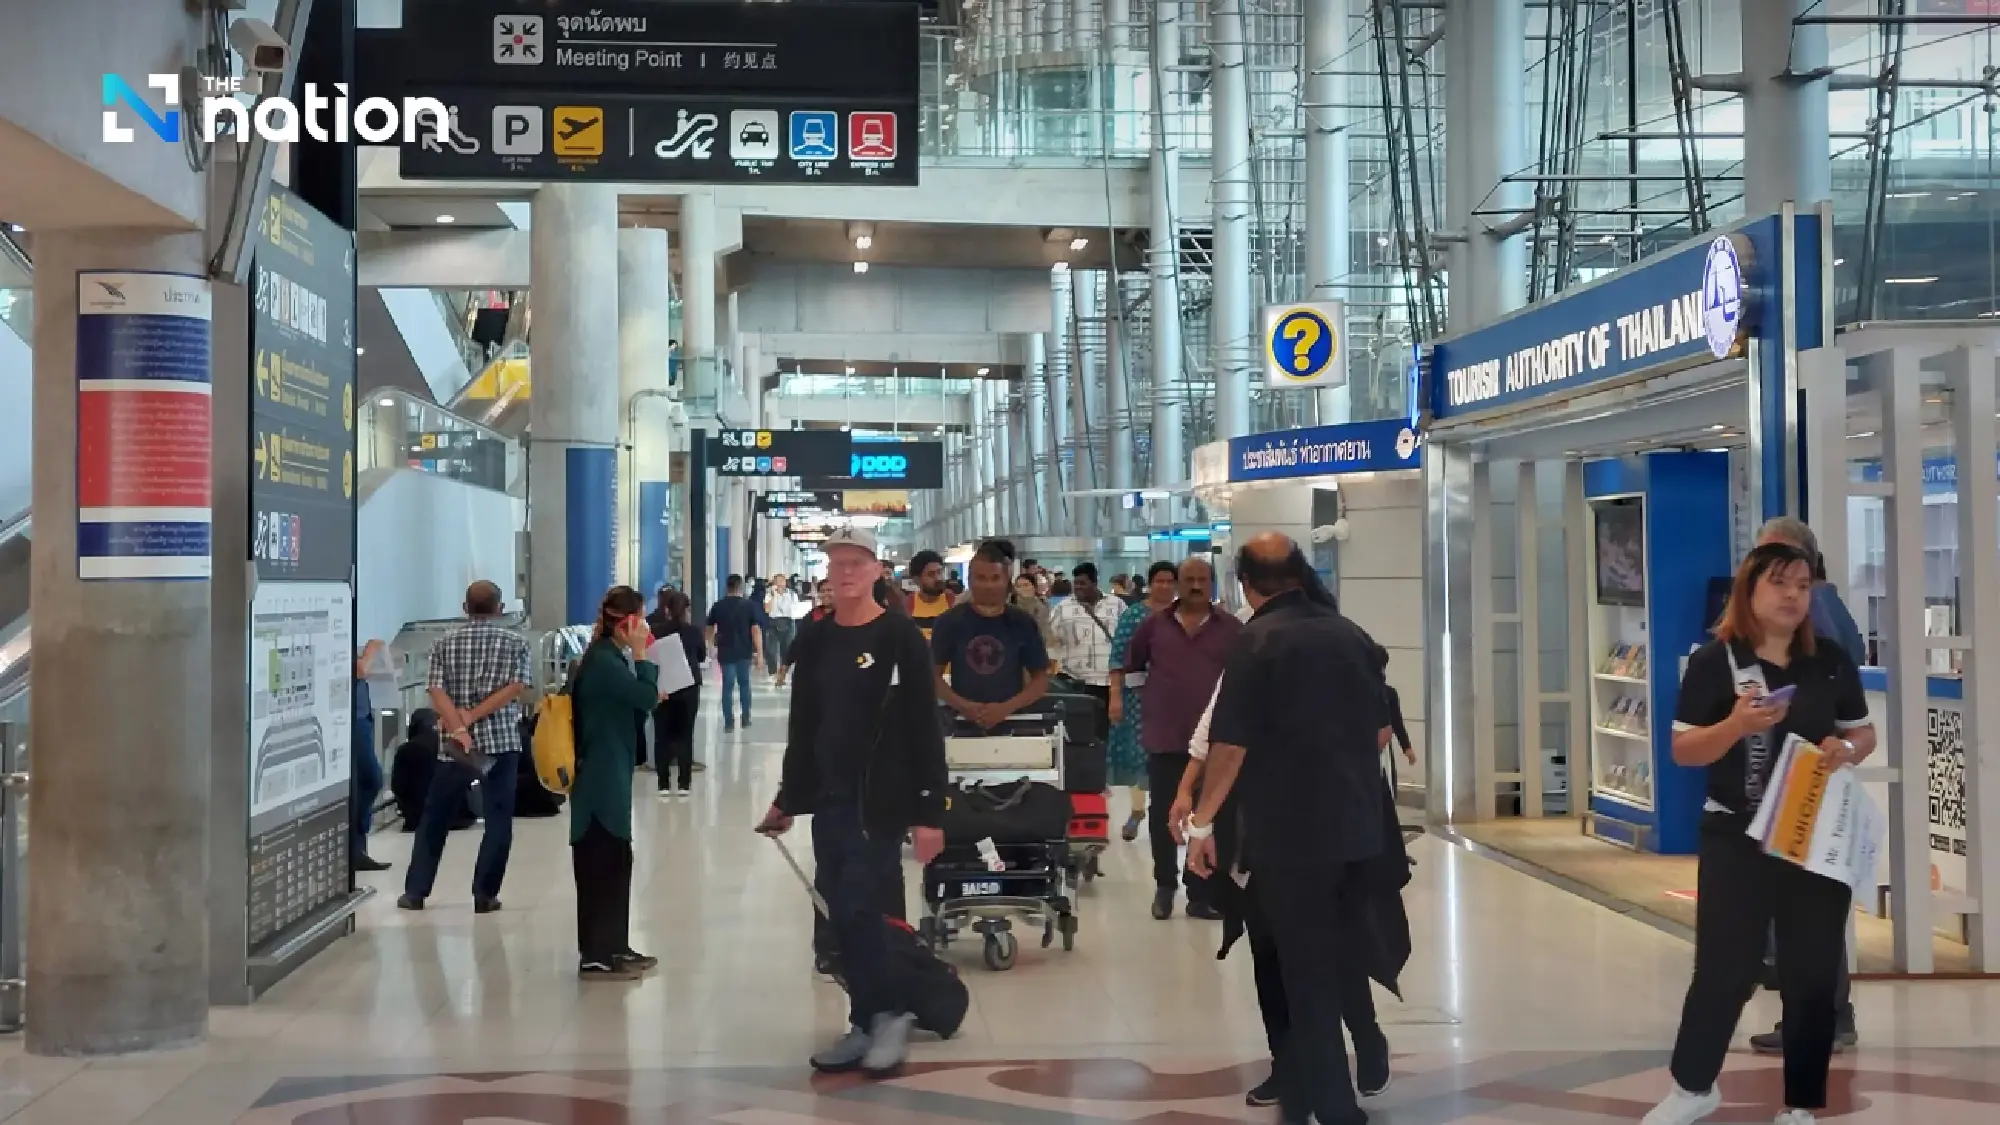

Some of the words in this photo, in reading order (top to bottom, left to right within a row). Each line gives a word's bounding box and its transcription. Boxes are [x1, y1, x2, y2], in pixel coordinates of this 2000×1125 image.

[557, 9, 646, 38] จุดนัดพบ
[556, 48, 629, 71] Meeting
[635, 50, 682, 67] Point
[724, 51, 777, 69] 约见点
[505, 114, 530, 146] P
[1448, 358, 1501, 406] TOURISM
[1505, 330, 1586, 392] AUTHORITY
[1588, 322, 1612, 370] OF
[1300, 439, 1371, 464] ท่าอากาศยาน
